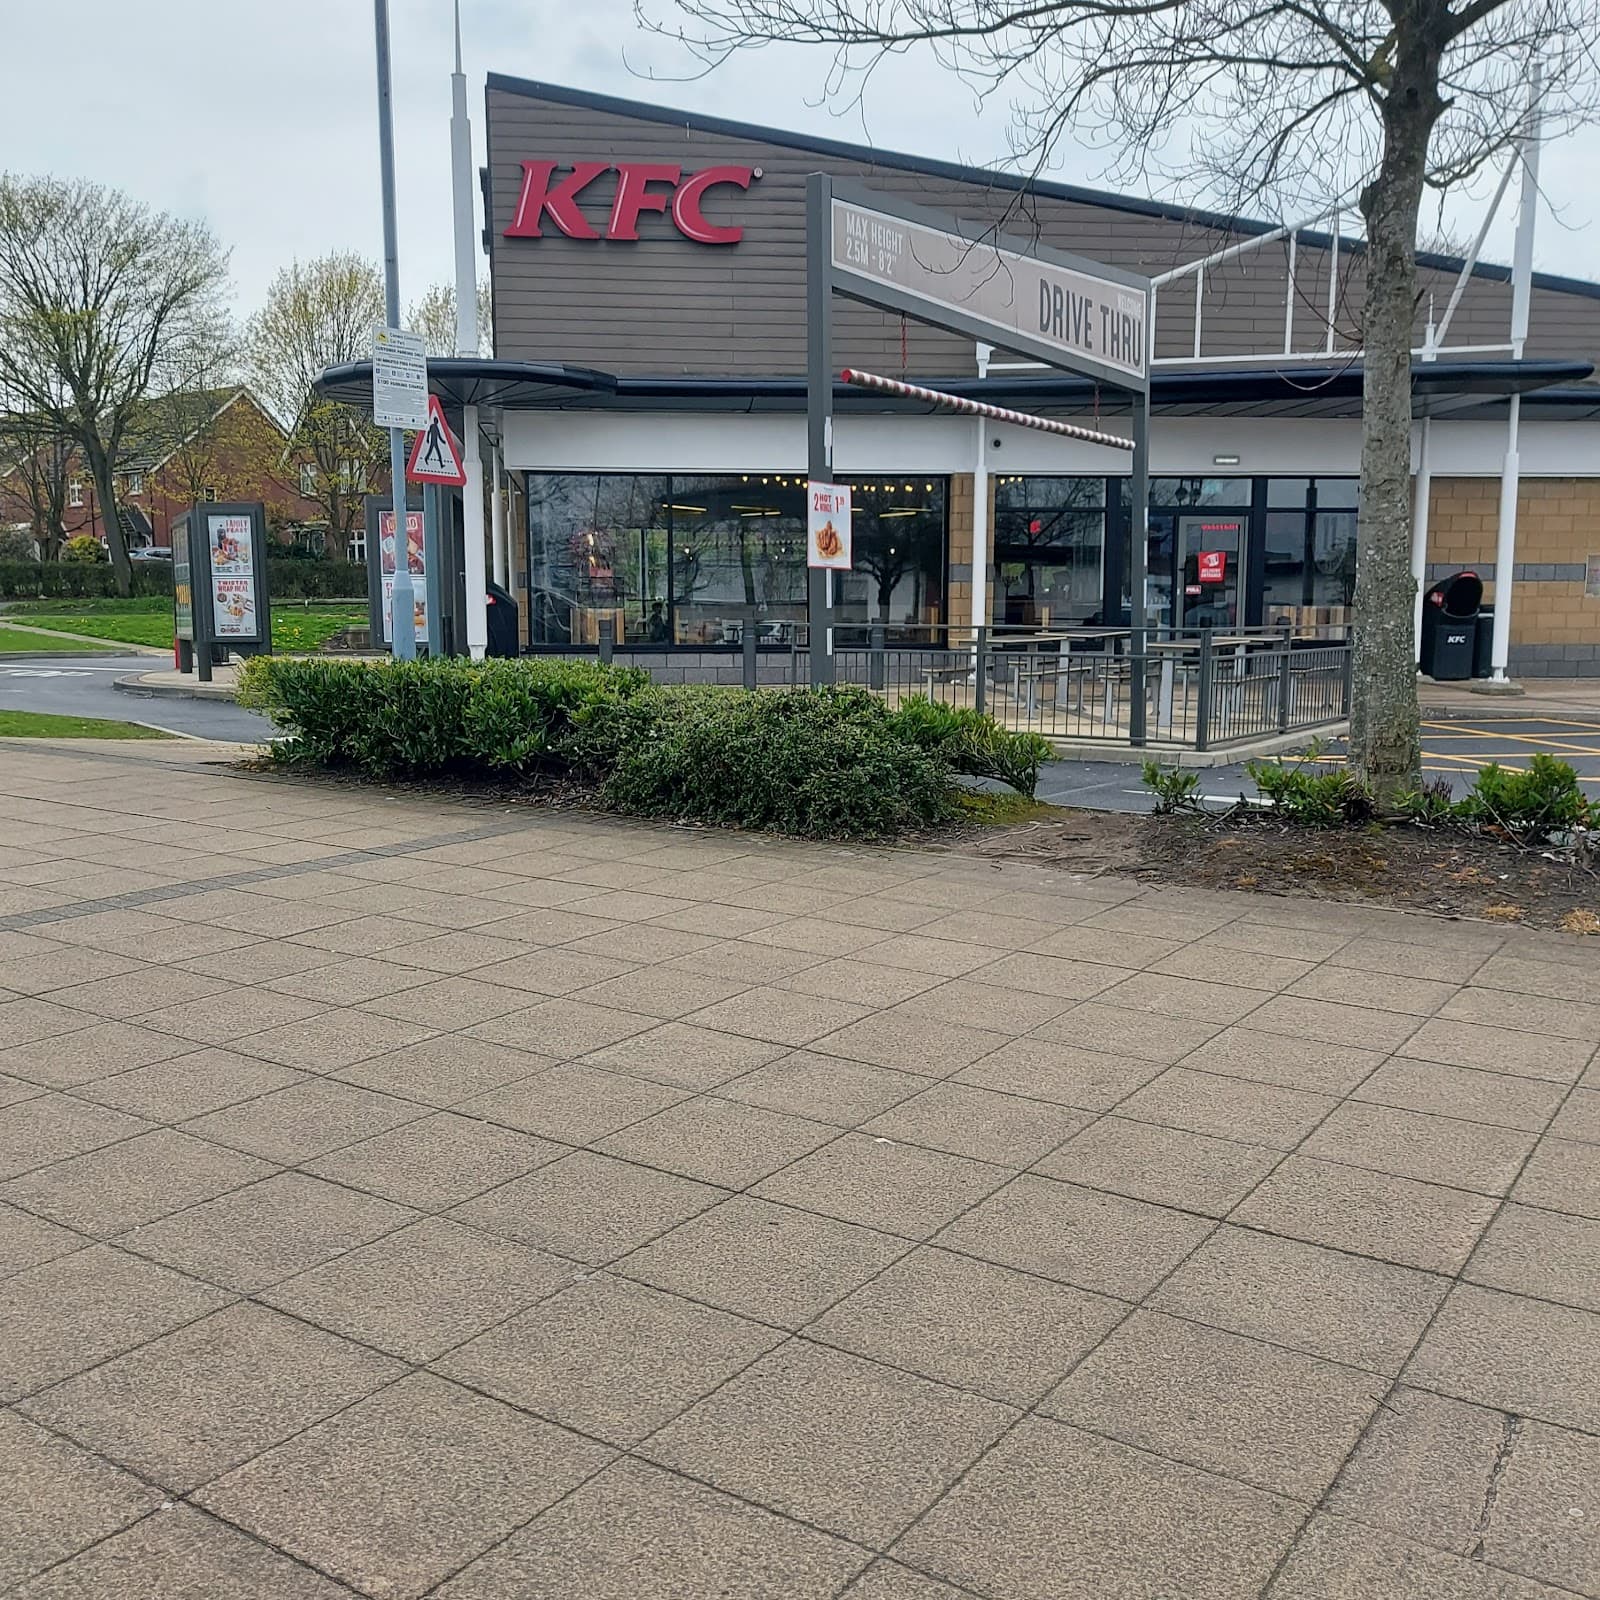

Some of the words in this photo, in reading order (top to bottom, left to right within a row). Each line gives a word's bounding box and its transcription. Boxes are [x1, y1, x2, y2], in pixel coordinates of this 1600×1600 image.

[503, 160, 751, 243] KFC
[846, 211, 868, 241] MAX
[871, 222, 903, 255] HEIGHT
[846, 237, 869, 265] 2.5M
[1039, 278, 1093, 350] DRIVE
[1100, 304, 1141, 367] THRU
[814, 493, 819, 512] 2
[820, 493, 832, 503] HOT
[1447, 635, 1466, 643] KFC
